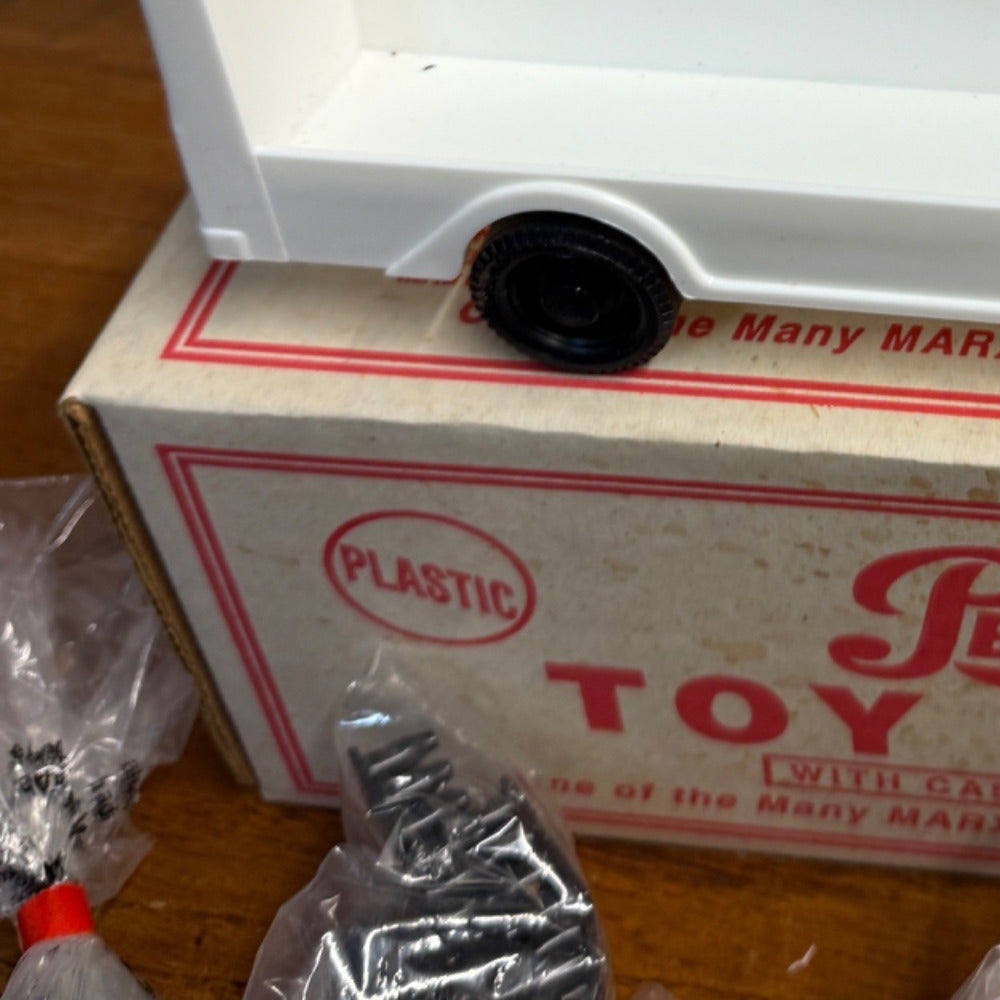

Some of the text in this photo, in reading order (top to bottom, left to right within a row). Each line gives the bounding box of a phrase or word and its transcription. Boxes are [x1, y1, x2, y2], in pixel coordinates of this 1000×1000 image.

[731, 313, 865, 354] Many
[340, 542, 518, 620] PLASTIC
[545, 661, 924, 756] TOY
[550, 776, 595, 798] ne
[614, 782, 654, 801] of
[673, 787, 738, 809] the
[757, 793, 871, 826] Many
[790, 762, 899, 793] WITH
